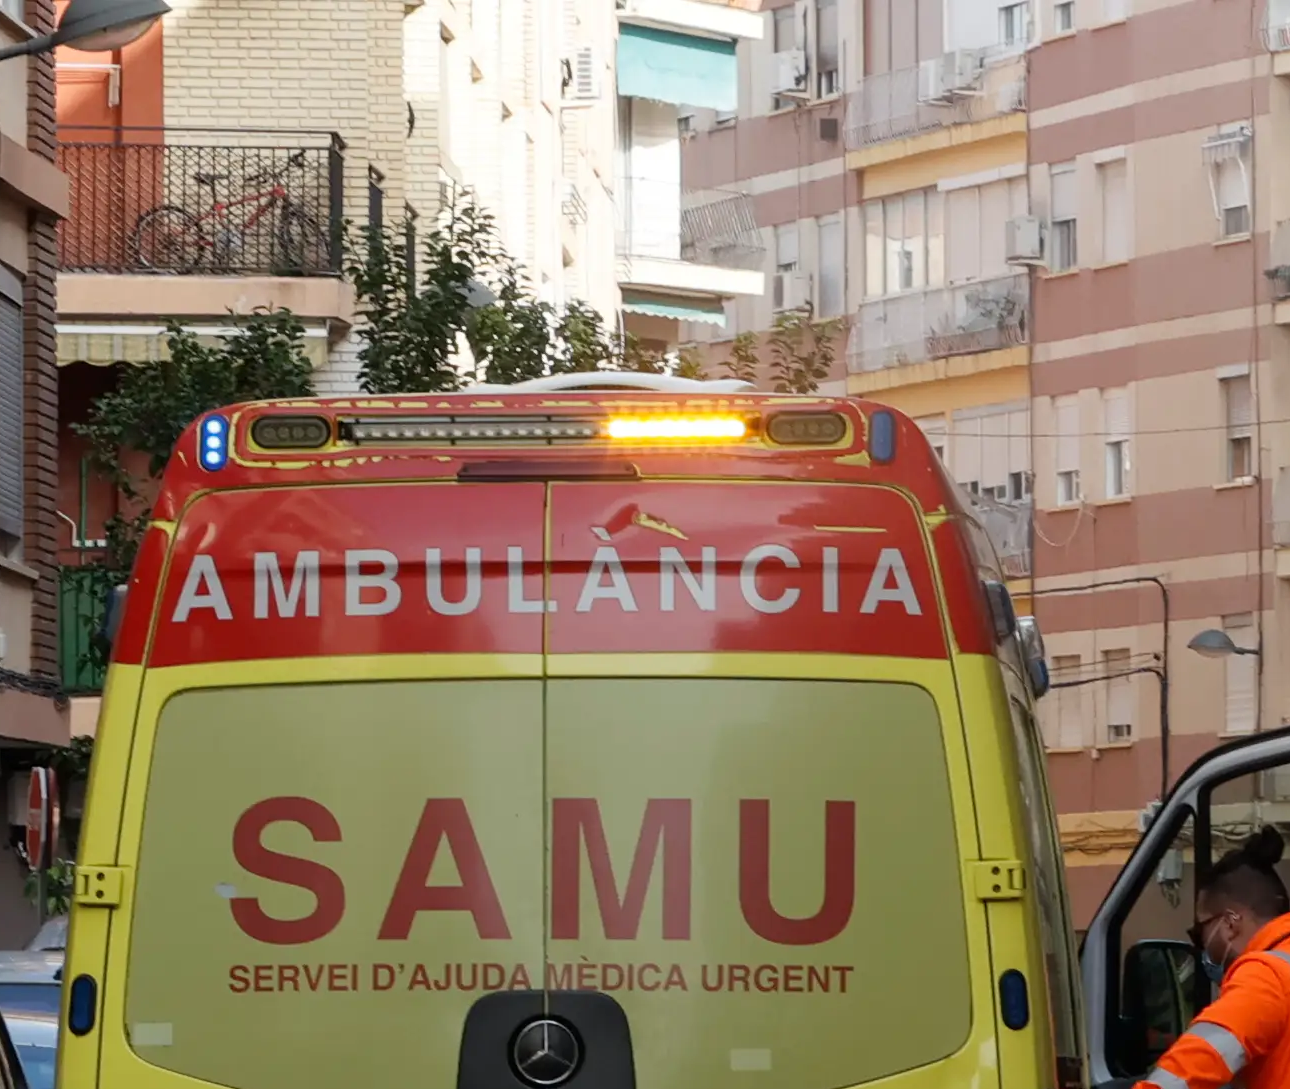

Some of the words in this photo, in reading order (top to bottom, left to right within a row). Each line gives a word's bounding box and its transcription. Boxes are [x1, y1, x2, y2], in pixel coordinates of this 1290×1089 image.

[172, 526, 922, 622] AMBULÀNCIA
[229, 796, 856, 945] SAMU
[228, 964, 358, 993] SERVEI
[547, 956, 688, 992] MÈDICA
[701, 964, 854, 994] URGENT
